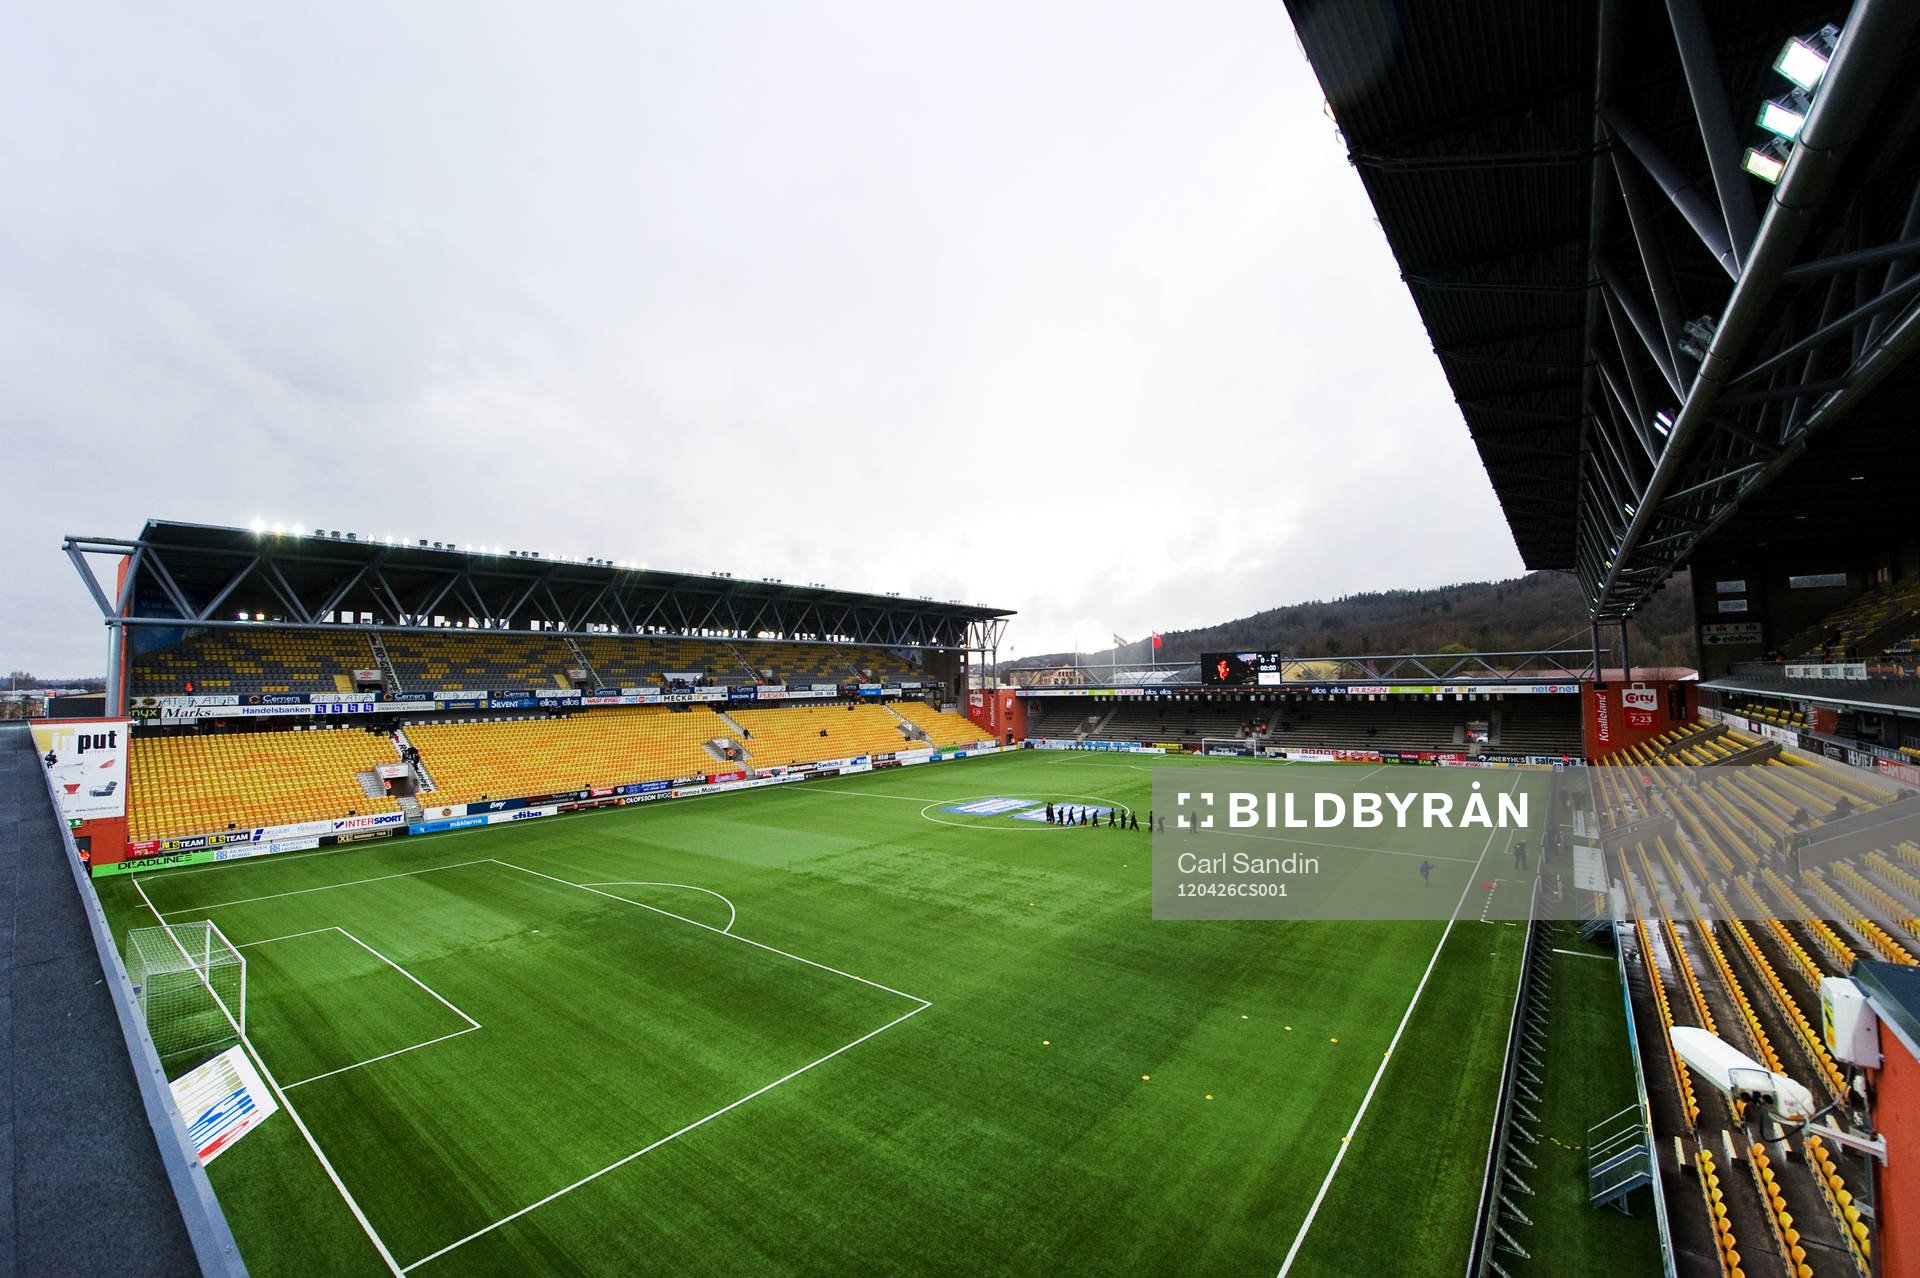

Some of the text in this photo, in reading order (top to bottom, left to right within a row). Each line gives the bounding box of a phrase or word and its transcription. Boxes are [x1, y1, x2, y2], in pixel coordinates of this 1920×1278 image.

[540, 697, 580, 707] ellos ellos
[242, 706, 311, 716] Handelsbanken
[1597, 692, 1609, 742] Knalleland
[626, 795, 657, 804] OLOFSSON
[345, 815, 403, 829] INTERSPORT
